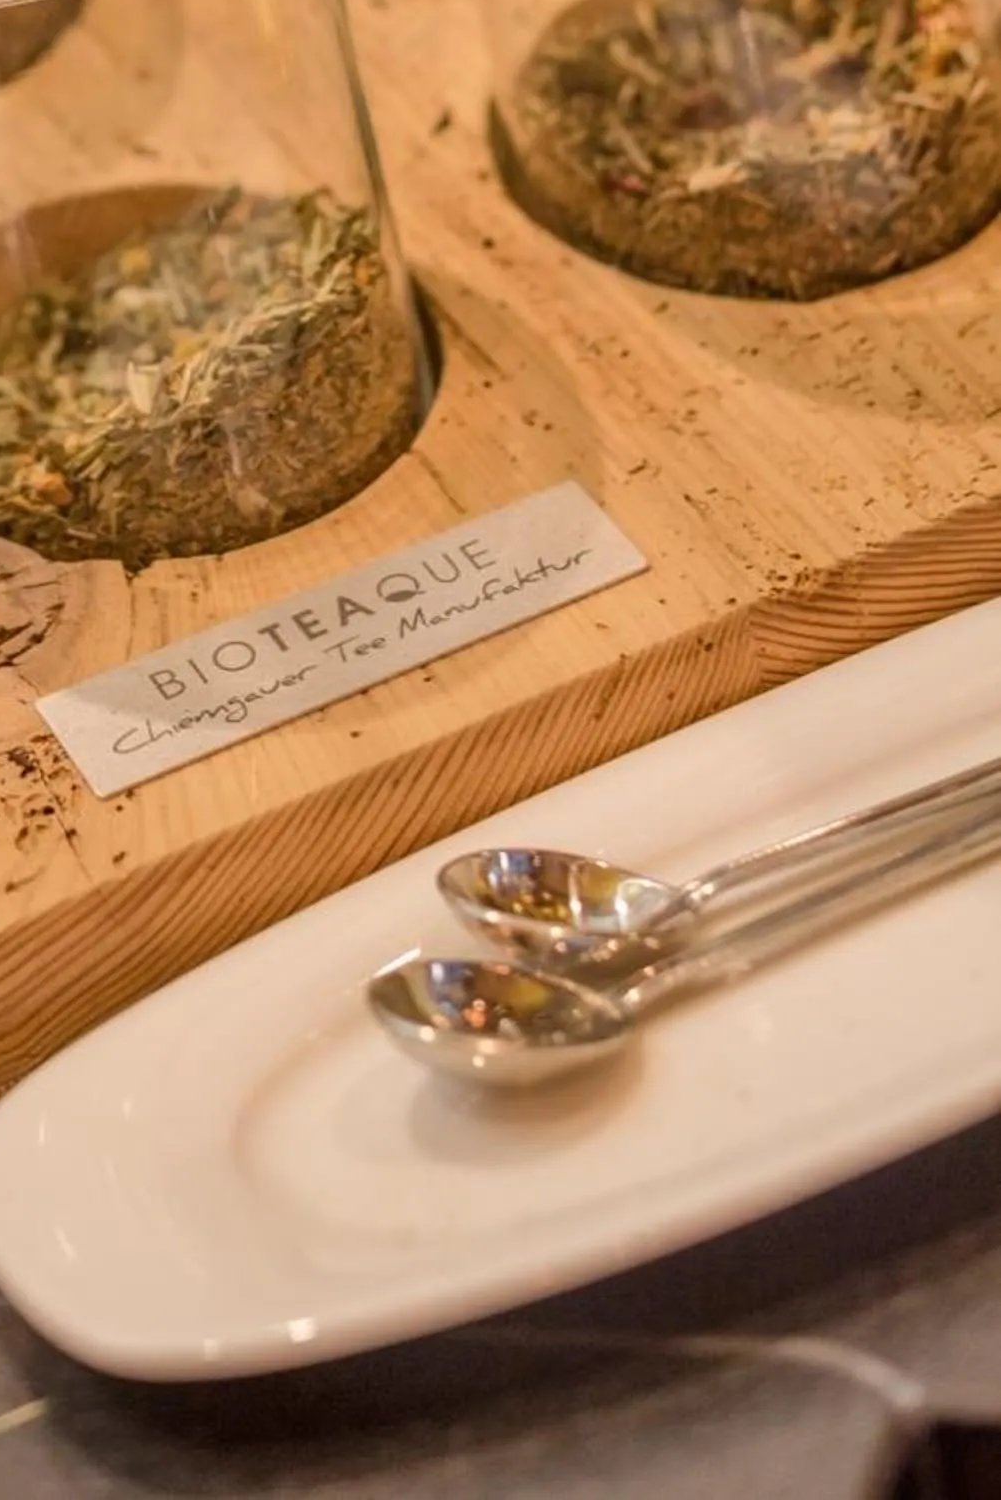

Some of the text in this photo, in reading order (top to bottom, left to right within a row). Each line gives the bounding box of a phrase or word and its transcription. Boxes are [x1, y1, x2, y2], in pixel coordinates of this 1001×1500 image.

[149, 538, 497, 701] BIOTEAQUE
[323, 634, 387, 662] Tee
[399, 548, 593, 639] Manufaktur
